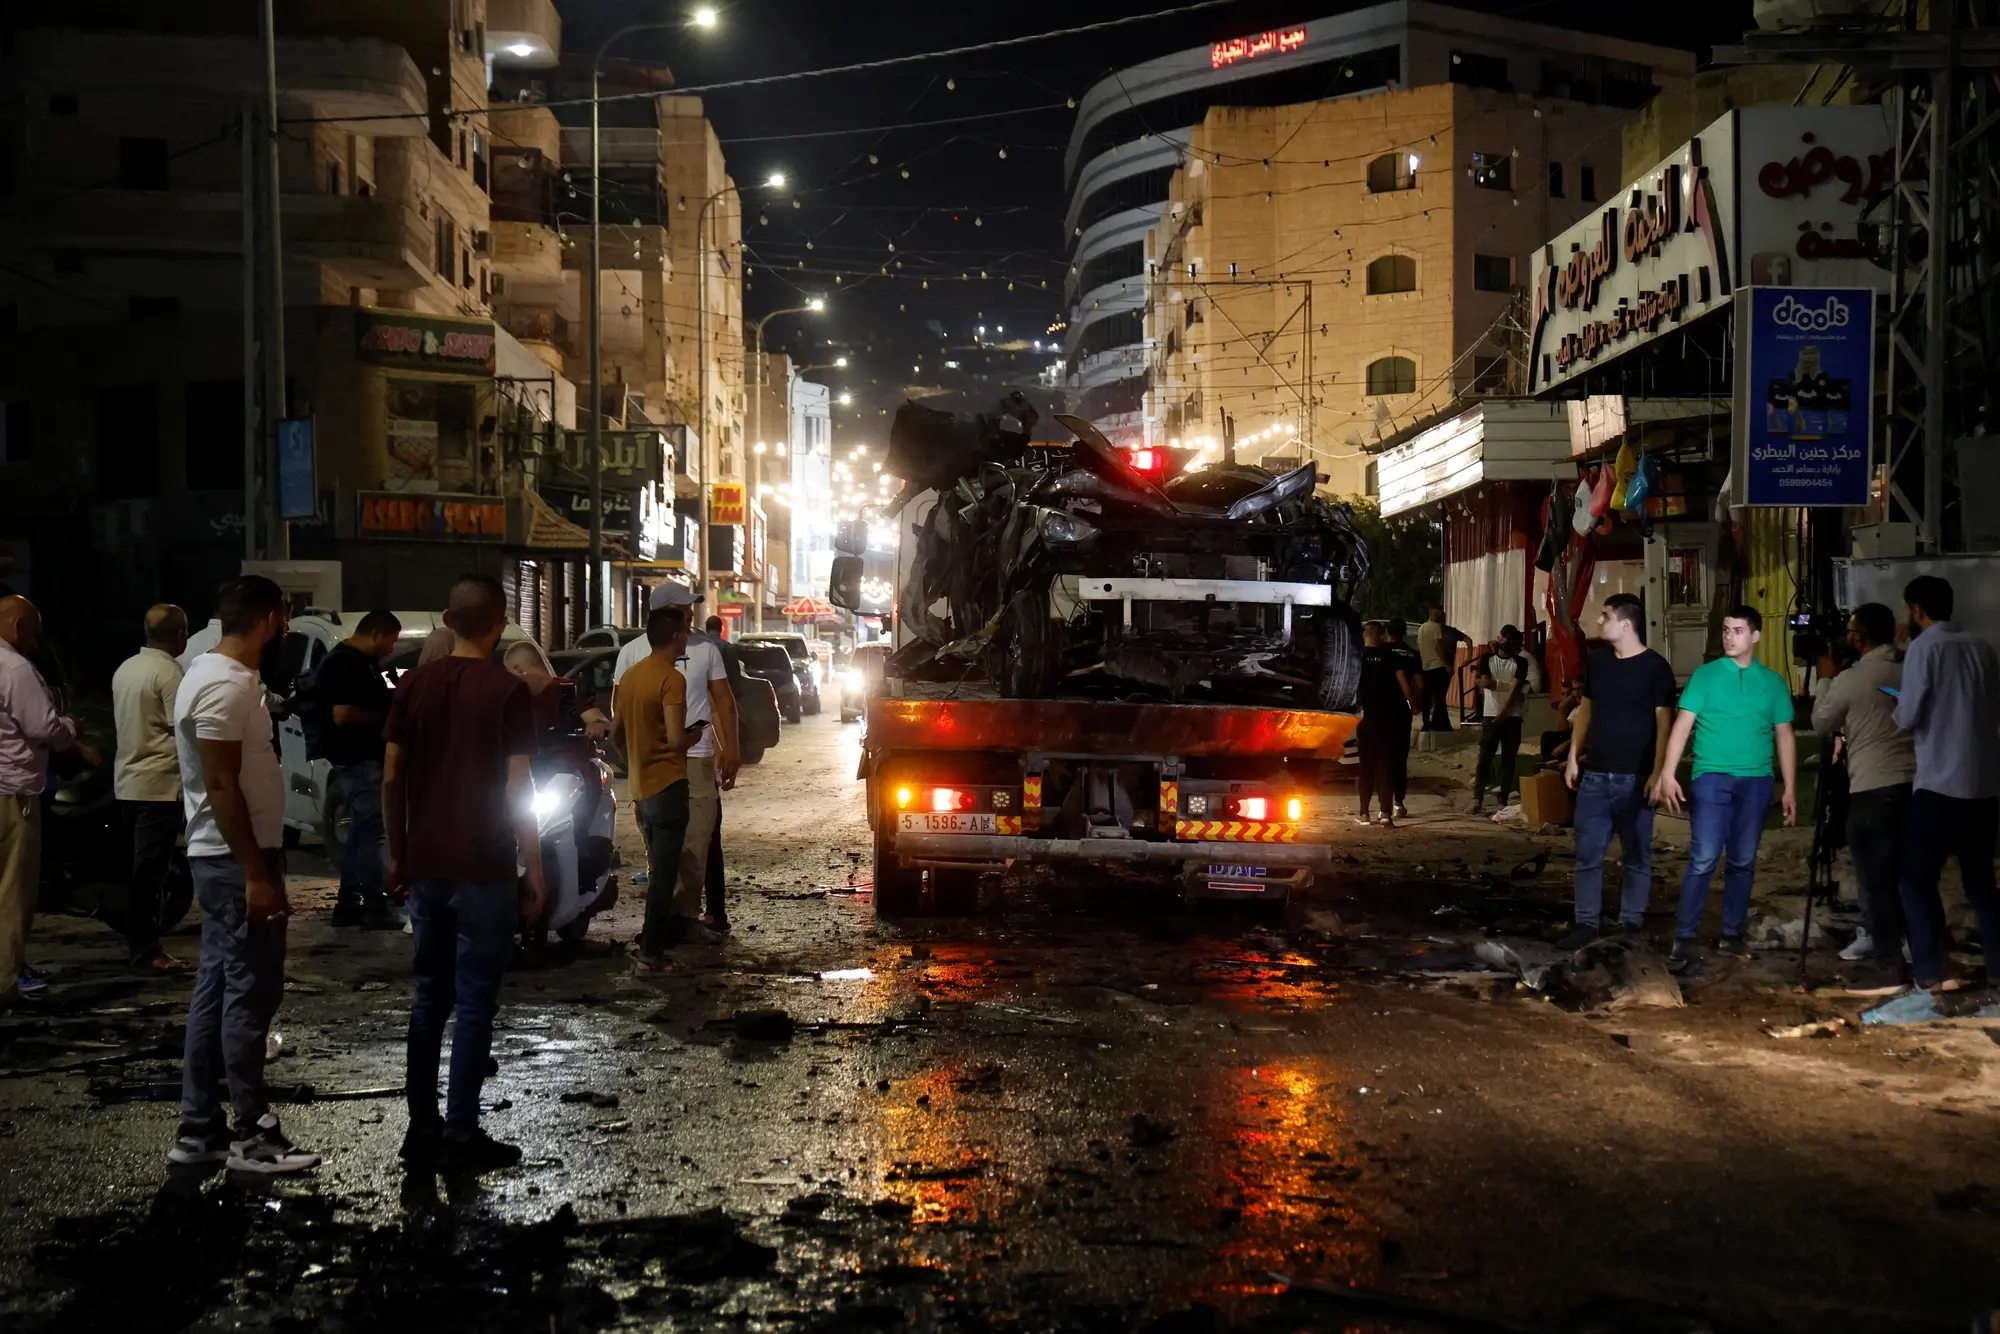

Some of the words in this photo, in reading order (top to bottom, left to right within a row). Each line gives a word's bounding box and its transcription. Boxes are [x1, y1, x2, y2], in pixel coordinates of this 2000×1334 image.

[1624, 164, 1680, 262] النجمة
[1558, 208, 1617, 311] للعروض
[1773, 295, 1849, 330] drools
[1752, 444, 1796, 460] البيطري
[1800, 447, 1828, 461] جنين
[1832, 445, 1861, 460] مركز
[571, 494, 632, 514] شاوما
